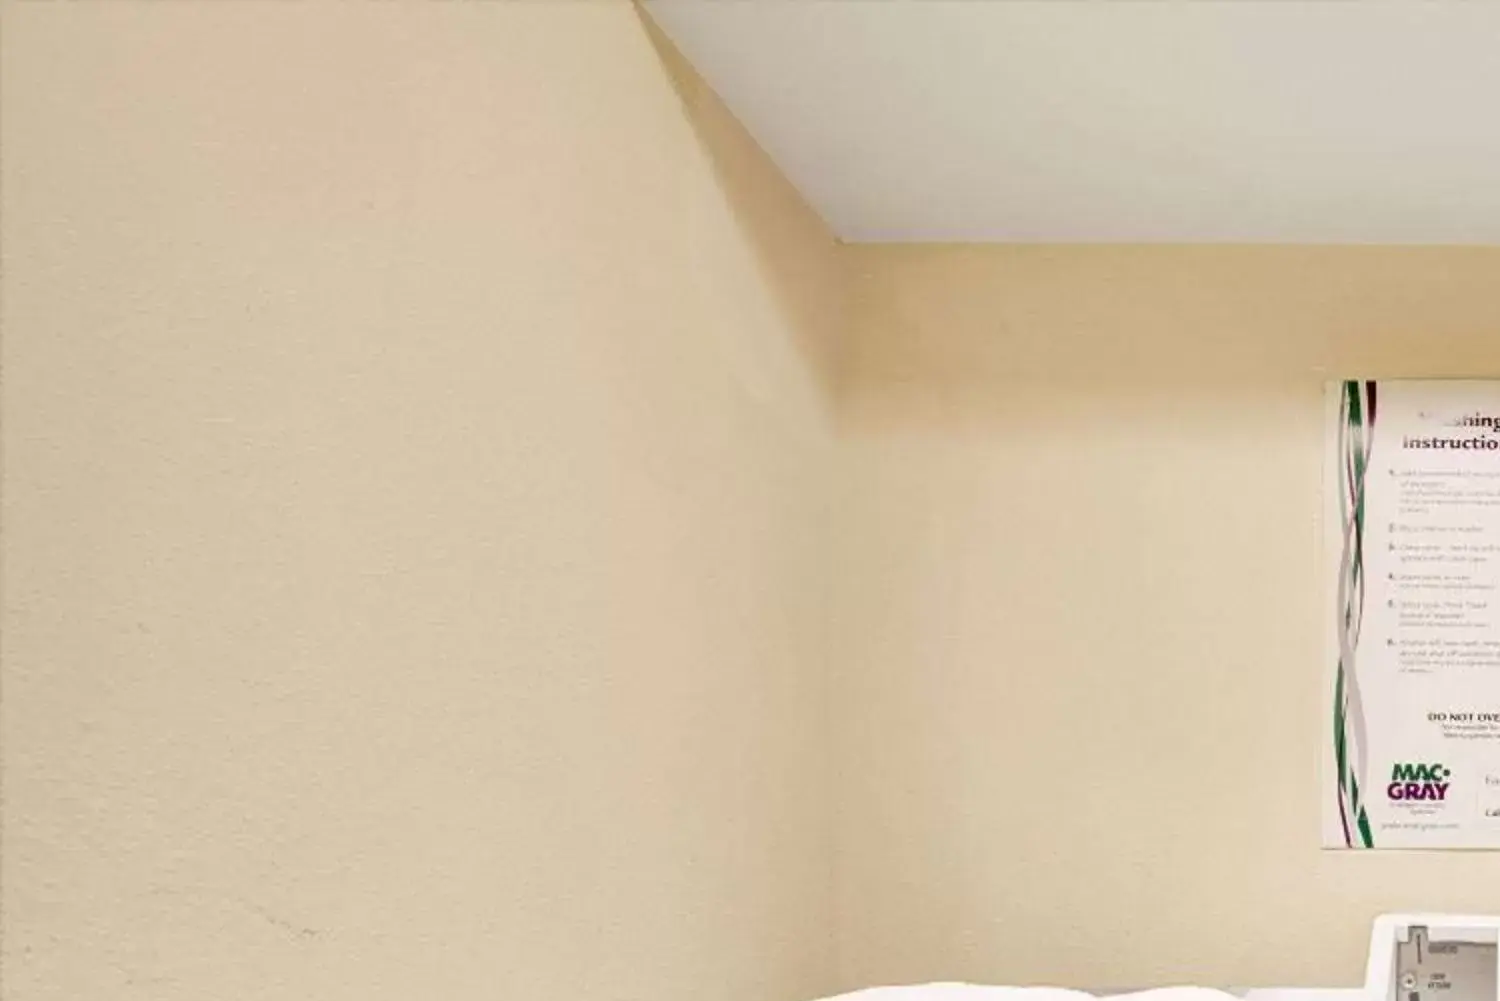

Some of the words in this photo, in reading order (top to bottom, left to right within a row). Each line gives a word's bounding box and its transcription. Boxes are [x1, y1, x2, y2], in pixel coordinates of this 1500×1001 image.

[1427, 713, 1446, 721] DO
[1450, 713, 1473, 721] NOT
[1387, 781, 1450, 801] GRAY
